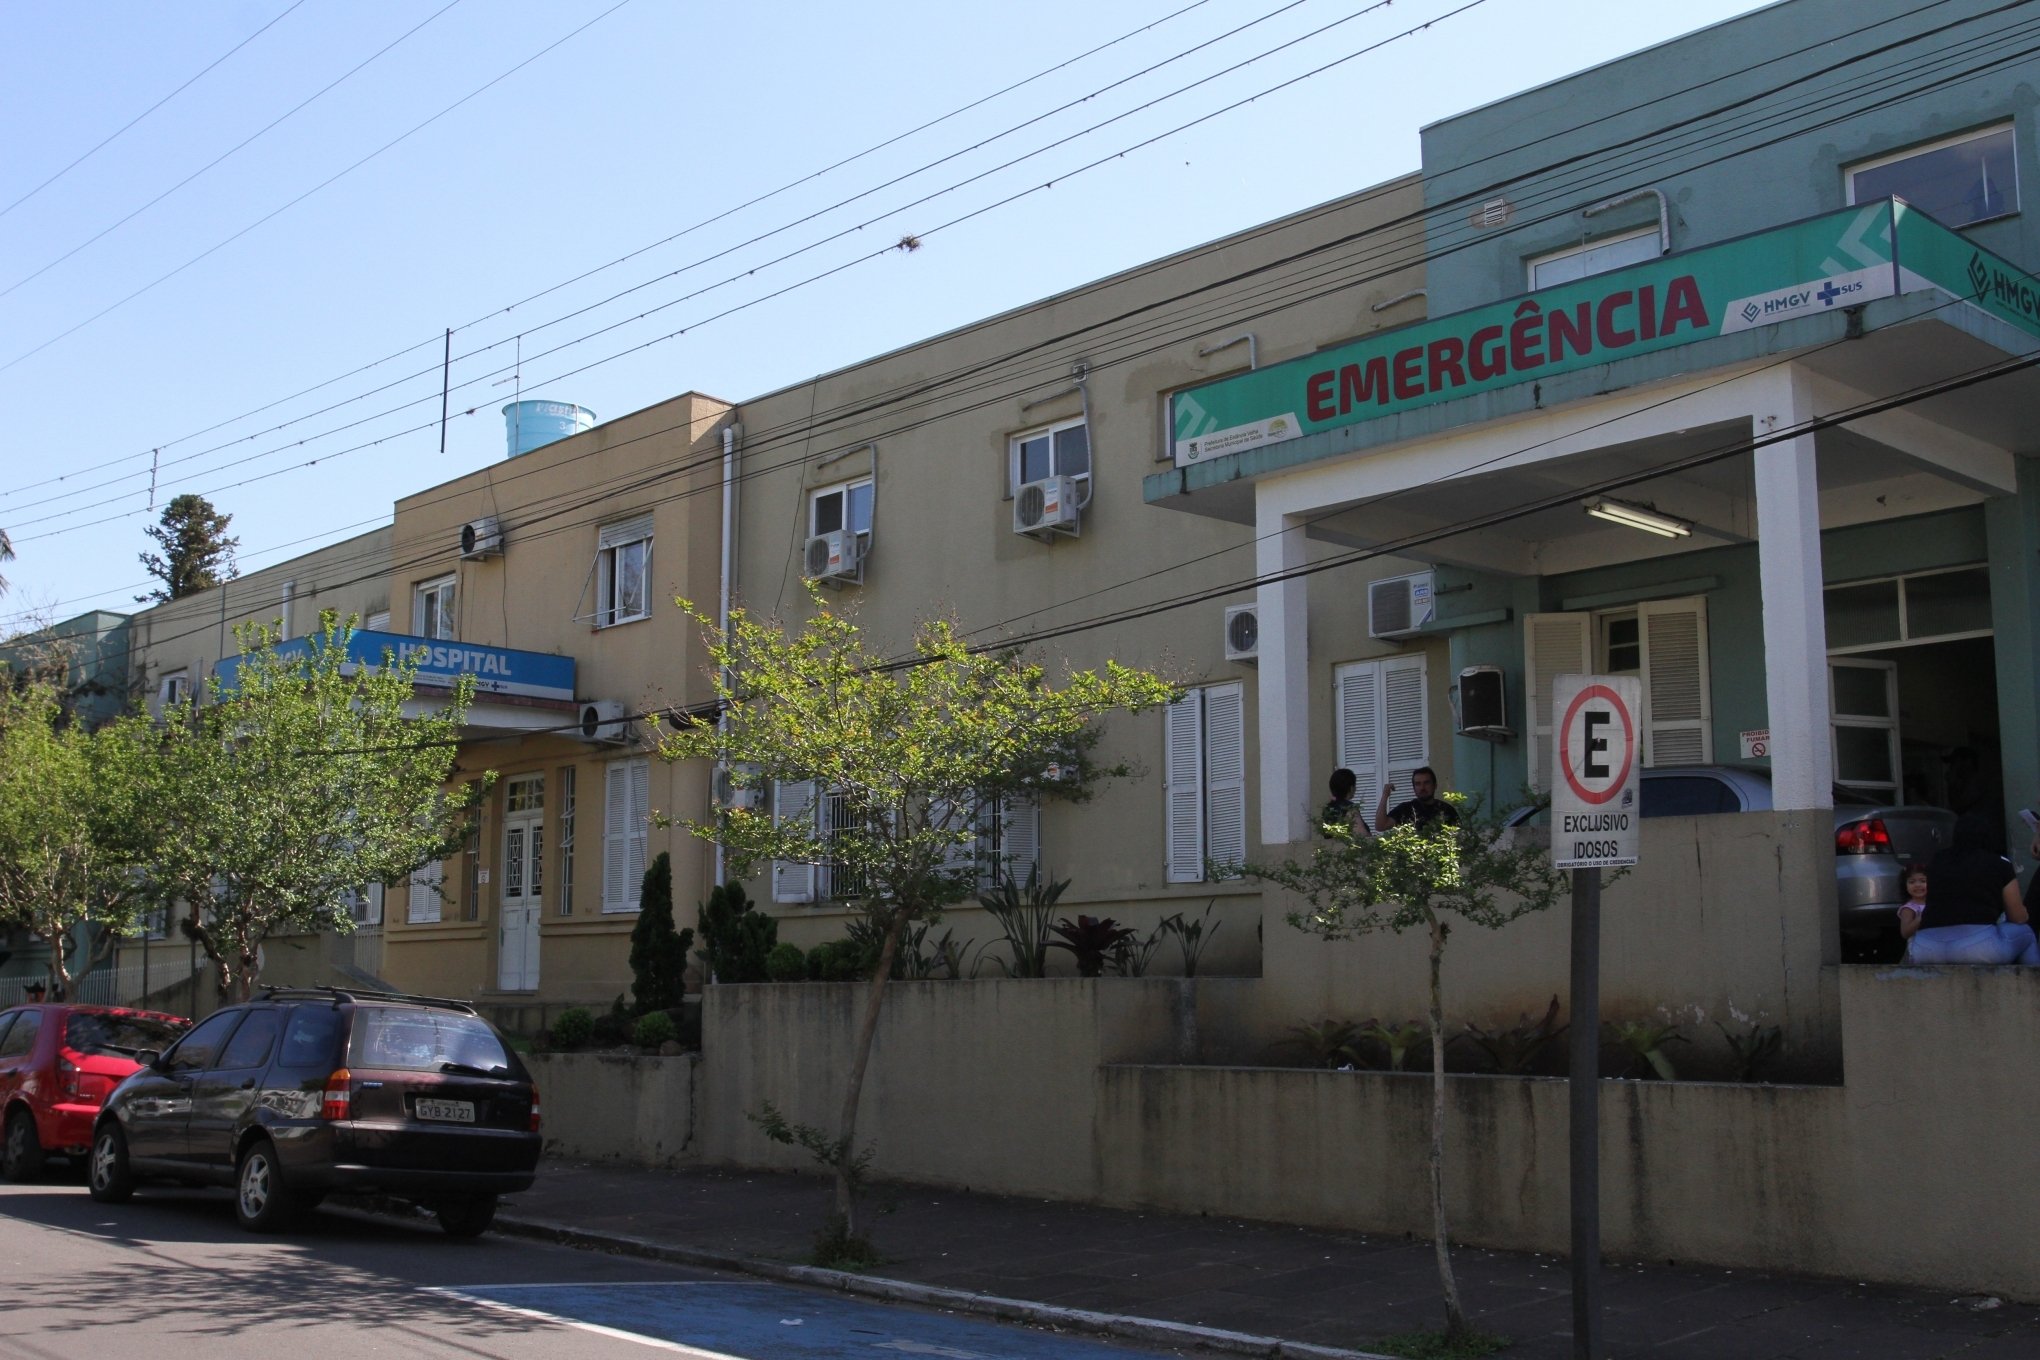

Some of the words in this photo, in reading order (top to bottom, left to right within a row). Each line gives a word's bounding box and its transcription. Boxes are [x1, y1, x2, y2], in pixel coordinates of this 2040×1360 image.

[1764, 291, 1811, 314] HMGV
[1840, 281, 1863, 295] SUS
[1306, 275, 1710, 422] EMERGÊNCIA
[398, 641, 513, 677] HOSPITAL
[1584, 711, 1611, 779] E
[1563, 813, 1630, 833] EXCLUSIVO
[1556, 860, 1588, 868] OBRIGATÓRIO
[1573, 839, 1619, 860] IDOSOS
